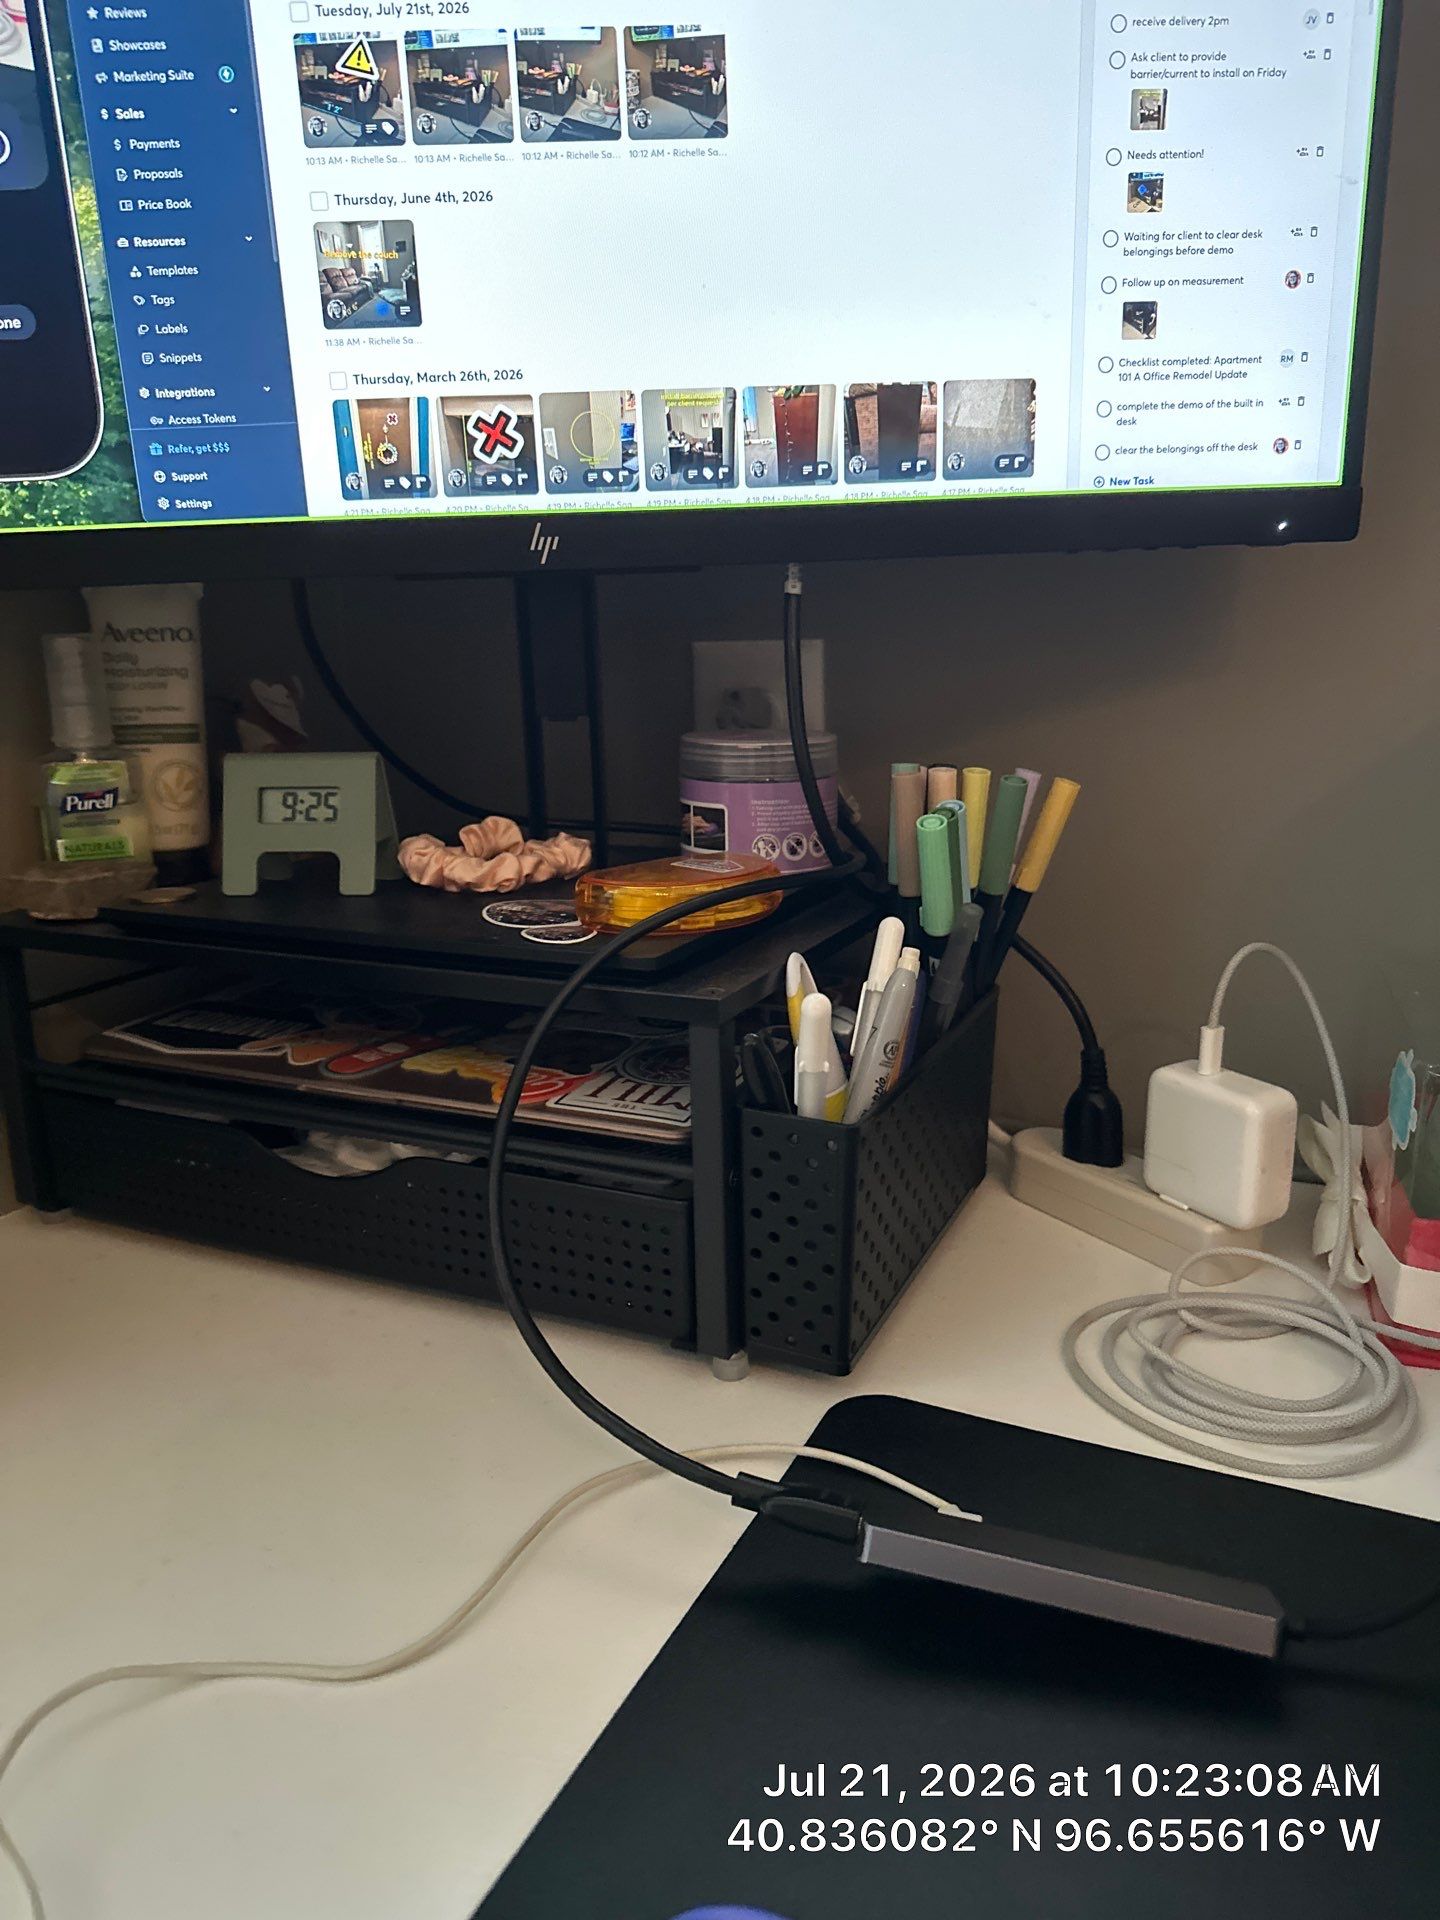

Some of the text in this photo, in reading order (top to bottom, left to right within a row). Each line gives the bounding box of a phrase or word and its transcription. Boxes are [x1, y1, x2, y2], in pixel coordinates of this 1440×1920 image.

[104, 7, 148, 19] Reviews
[315, 2, 470, 18] Tuesday, July 21st, 2026
[1132, 16, 1230, 29] receive delivery 2pm
[109, 39, 167, 51] Showcases
[1131, 51, 1227, 64] Ask client to provide
[113, 70, 195, 84] Marketing Suite
[1130, 67, 1287, 80] barrier/current to install on Friday
[115, 108, 145, 120] Sales
[129, 138, 181, 152] Payments
[328, 156, 343, 165] AM
[351, 155, 384, 165] Richelle
[436, 154, 451, 163] AM
[459, 153, 492, 163] Richelle
[544, 151, 558, 161] AM
[567, 150, 599, 160] Richelle
[651, 149, 665, 159] AM
[673, 148, 706, 158] Richelle
[1127, 149, 1204, 161] Needs attention!
[133, 168, 183, 182] Proposals
[138, 198, 192, 210] Price Book
[334, 190, 494, 208] Thursday, June 4th, 2026
[133, 236, 186, 248] Resources
[1124, 229, 1264, 243] Waiting for client to clear desk
[1123, 244, 1234, 258] belongings before demo
[146, 265, 199, 278] Templates
[1122, 276, 1245, 289] Follow up on measurement
[151, 294, 176, 307] Tags
[155, 323, 189, 335] Labels
[346, 338, 360, 346] AM
[368, 337, 400, 346] Richelle
[159, 352, 203, 365] Snippets
[1119, 355, 1263, 368] Checklist completed: Apartment
[353, 369, 524, 386] Thursday, March 26th, 2026
[1118, 370, 1248, 382] 101 A Office Remodel Update
[155, 387, 216, 400] Integrations
[1116, 398, 1264, 413] complete the demo of the built in
[168, 413, 237, 425] Access Tokens
[1116, 417, 1137, 427] desk
[168, 441, 231, 456] Refer, get $$$
[1115, 441, 1259, 455] clear the belongings off the desk
[171, 471, 208, 483] Support
[1110, 476, 1155, 486] New Task
[175, 498, 212, 511] Settings
[530, 522, 559, 565] hp
[103, 621, 193, 643] Aveeno
[65, 793, 114, 812] Purell
[282, 792, 338, 822] 9:25
